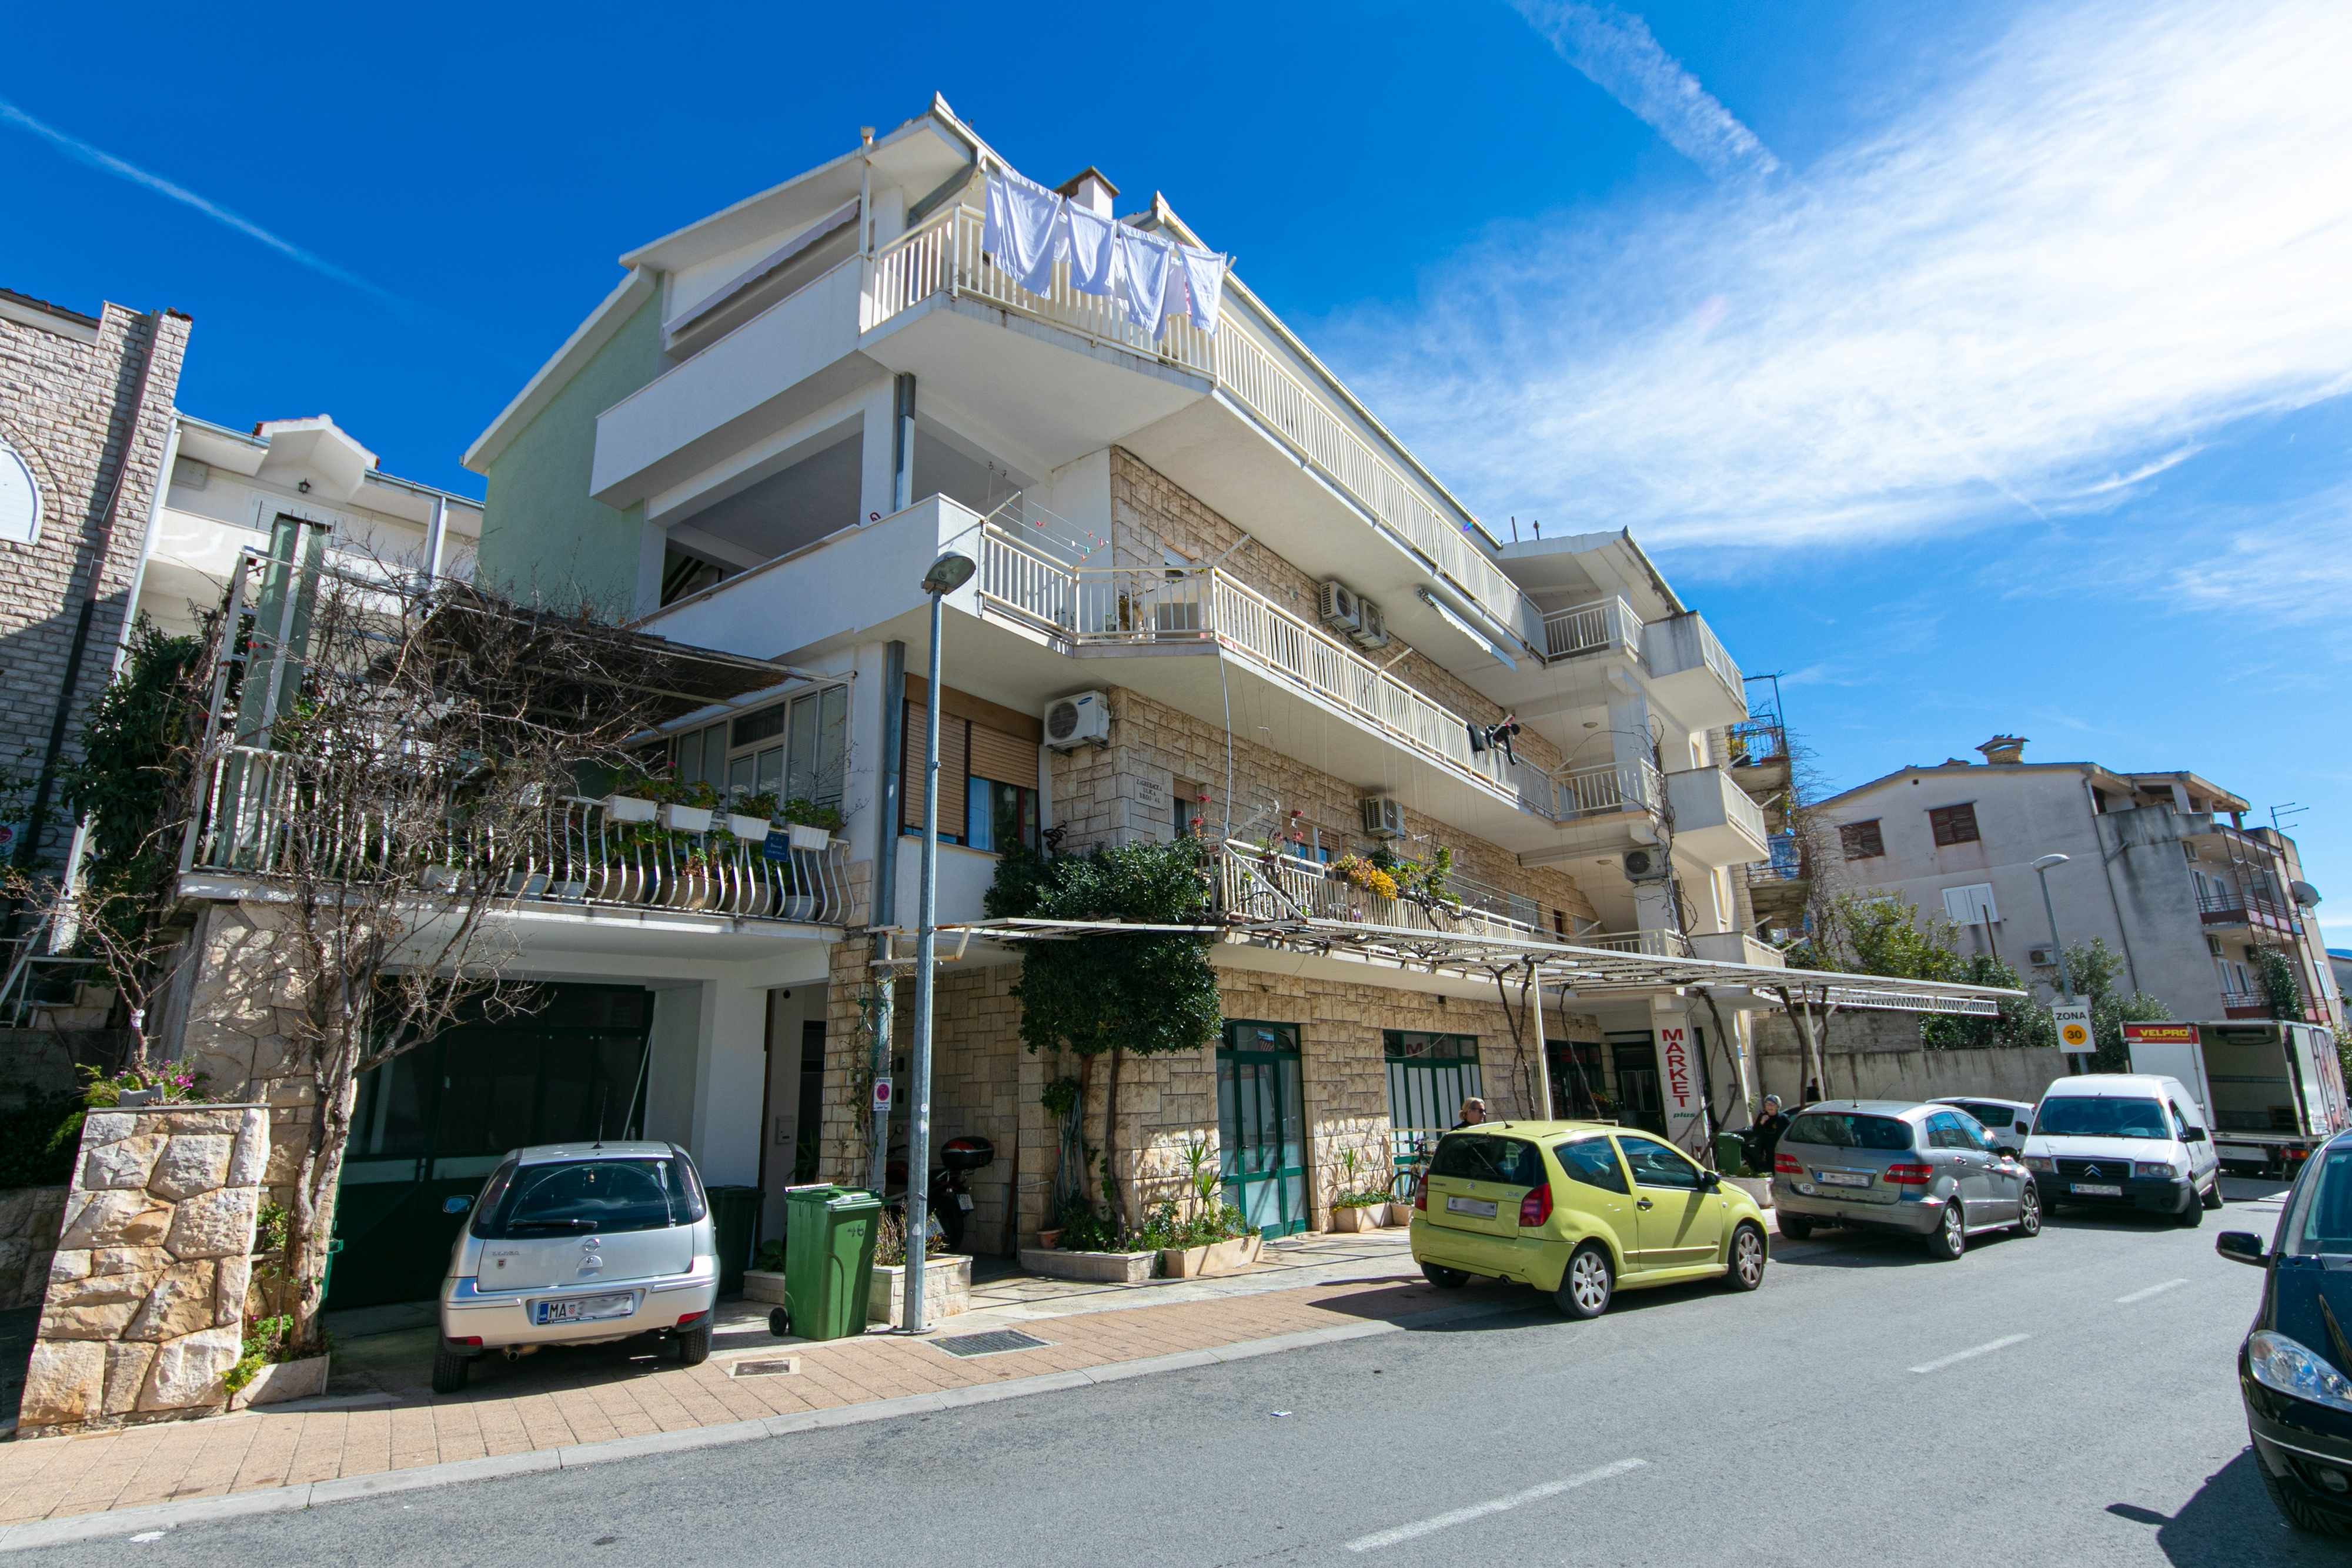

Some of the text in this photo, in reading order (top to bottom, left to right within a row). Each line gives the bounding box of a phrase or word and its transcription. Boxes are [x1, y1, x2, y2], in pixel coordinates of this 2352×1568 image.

[2056, 1012, 2086, 1020] ZONA
[2067, 1030, 2082, 1039] 30
[1662, 1028, 1690, 1108] MARKET
[1802, 1184, 1811, 1194] HR
[549, 1303, 566, 1318] MA
